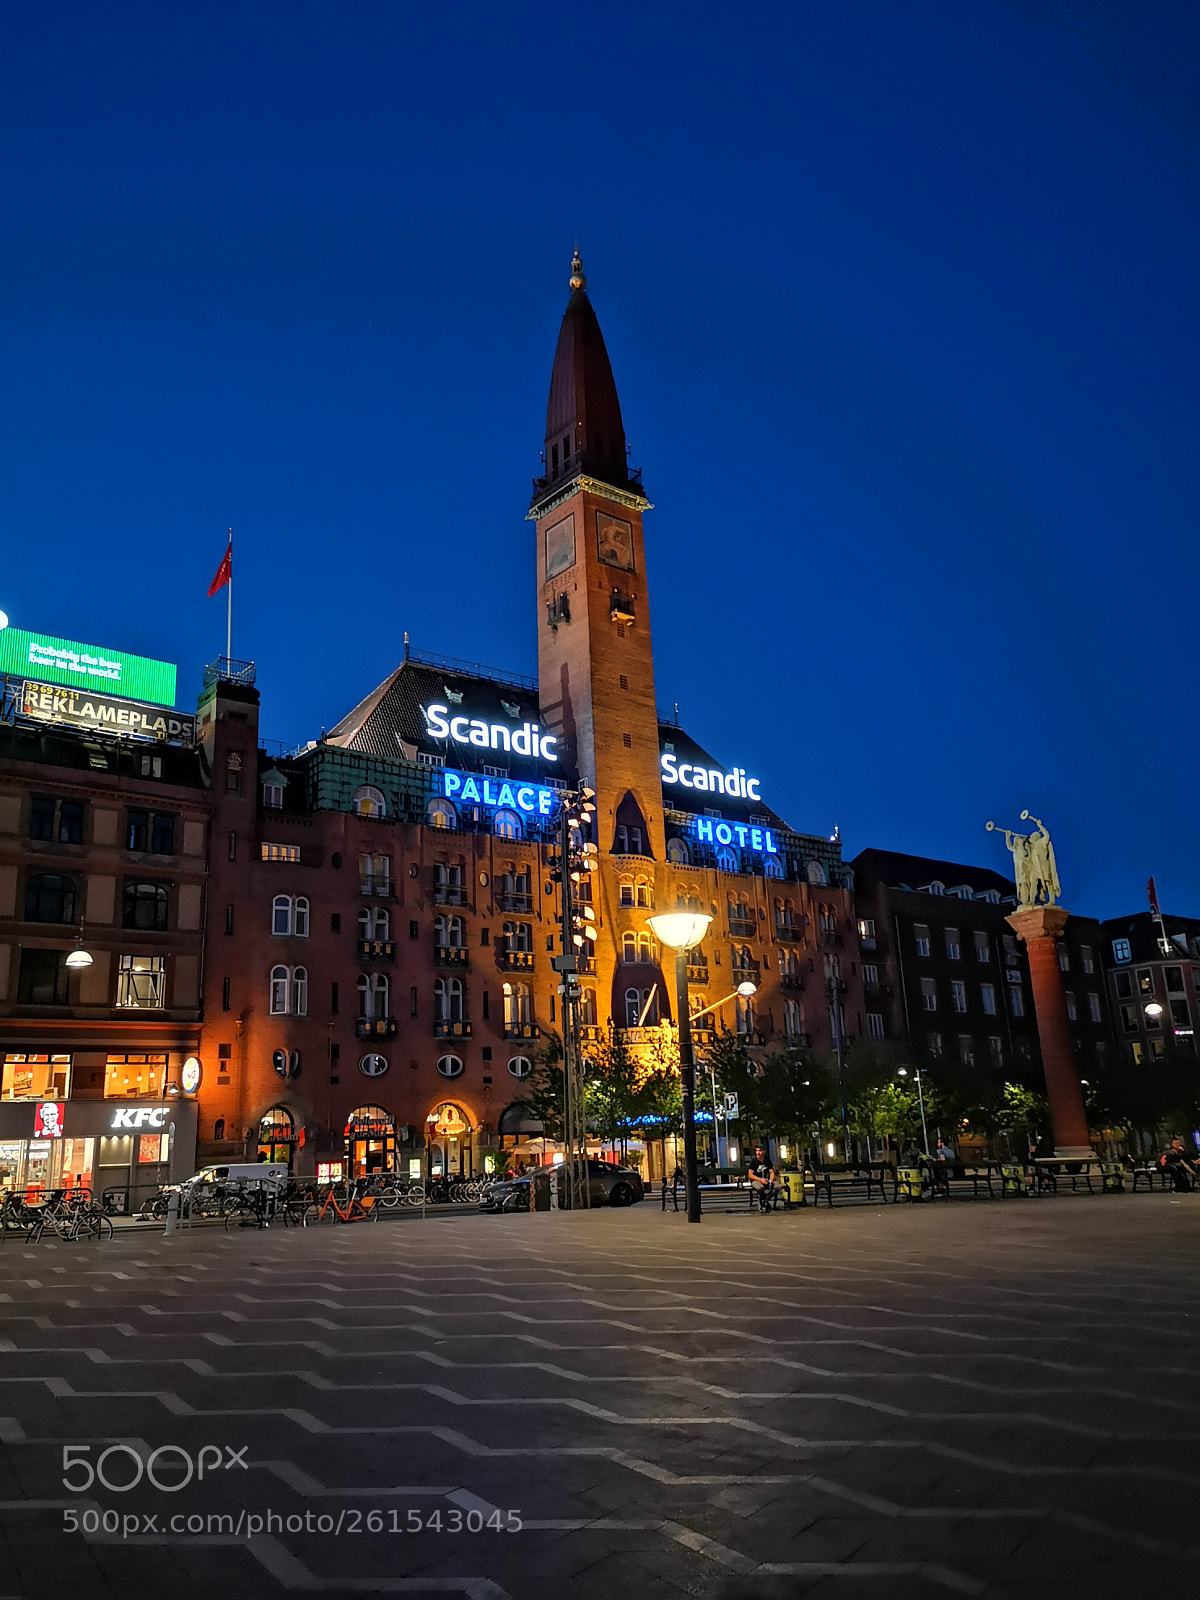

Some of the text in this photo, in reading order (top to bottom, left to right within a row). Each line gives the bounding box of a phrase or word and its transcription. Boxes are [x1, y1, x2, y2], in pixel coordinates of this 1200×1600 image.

[25, 690, 193, 736] REKLAMEPLADS
[26, 683, 80, 701] 39 69 76 11
[426, 704, 558, 762] Scandic
[444, 772, 553, 815] PALACE
[661, 753, 762, 801] Scandic
[696, 818, 777, 854] HOTEL
[111, 1107, 171, 1128] KFC
